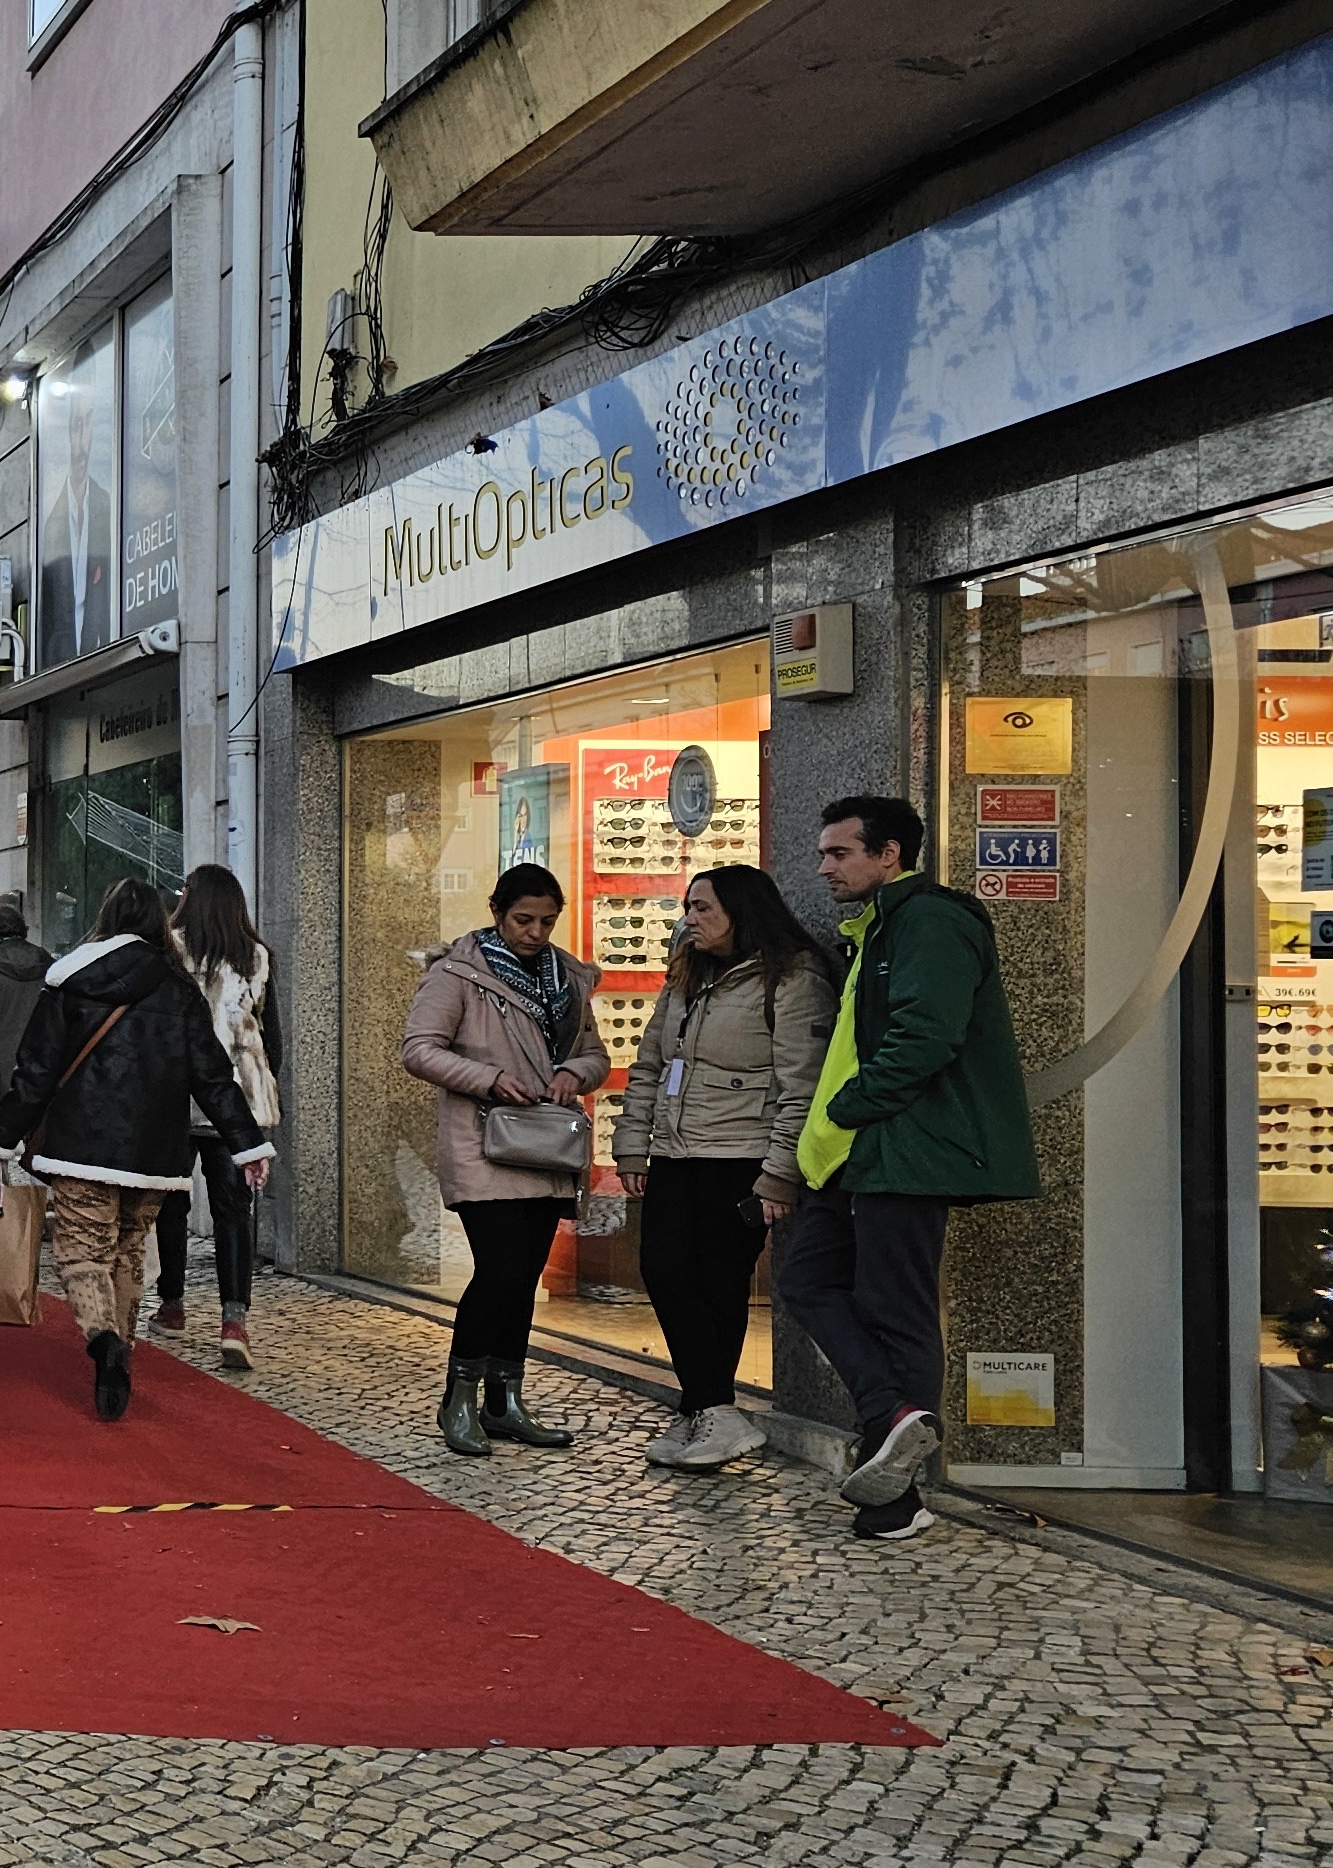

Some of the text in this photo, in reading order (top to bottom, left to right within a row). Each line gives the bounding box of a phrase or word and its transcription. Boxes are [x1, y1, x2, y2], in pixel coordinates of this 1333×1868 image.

[383, 445, 634, 597] MultiOpticas
[126, 572, 144, 613] DE
[777, 663, 817, 680] PROSEGUR
[983, 1361, 1048, 1372] MULTICARE
